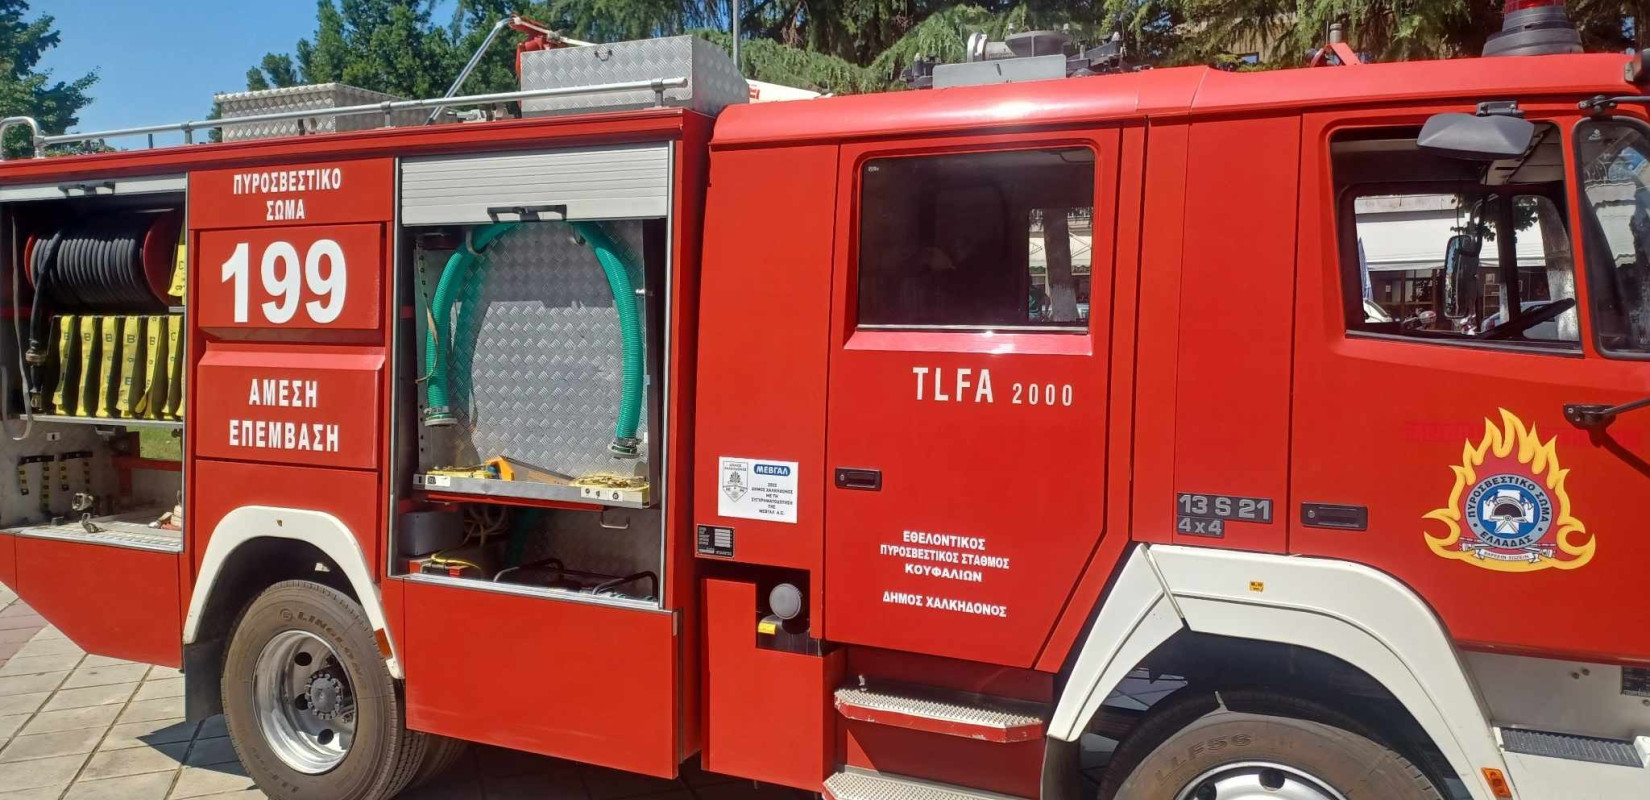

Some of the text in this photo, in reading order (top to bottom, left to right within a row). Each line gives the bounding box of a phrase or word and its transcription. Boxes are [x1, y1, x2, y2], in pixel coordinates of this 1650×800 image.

[234, 168, 341, 194] ΠΥΡΟΣΒΕΣΤΙΚΟ
[266, 199, 305, 220] ΣΩΜΑ
[222, 239, 346, 324] 199
[248, 378, 317, 408] ΑΜΕΣΗ
[913, 367, 1072, 406] TLFA 2000
[230, 420, 338, 452] ΕΠΕΜΒΑΣΗ
[756, 466, 788, 476] ΜΕΒΓΑΛ
[1179, 494, 1270, 520] 13 S 21
[1468, 476, 1550, 522] ΠΥΡΟΣΒΕΣΤΙΚΟ ΣΩΜΑ
[1178, 517, 1222, 535] 4x4
[1480, 531, 1533, 547] ΕΛΛΑΔΑΣ
[904, 530, 986, 550] ΕΘΕΛΟΝΤΙΚΟΣ
[880, 544, 1010, 569] ΠΥΡΟΣΒΕΣΤΙΚΟΣ ΣΤΑΘΜΟΣ
[905, 564, 982, 582] ΚΟΥΦΑΛΙΩΝ
[883, 591, 1006, 617] ΔΗΜΟΣ ΧΑΛΚΗΔΟΝΟΣ
